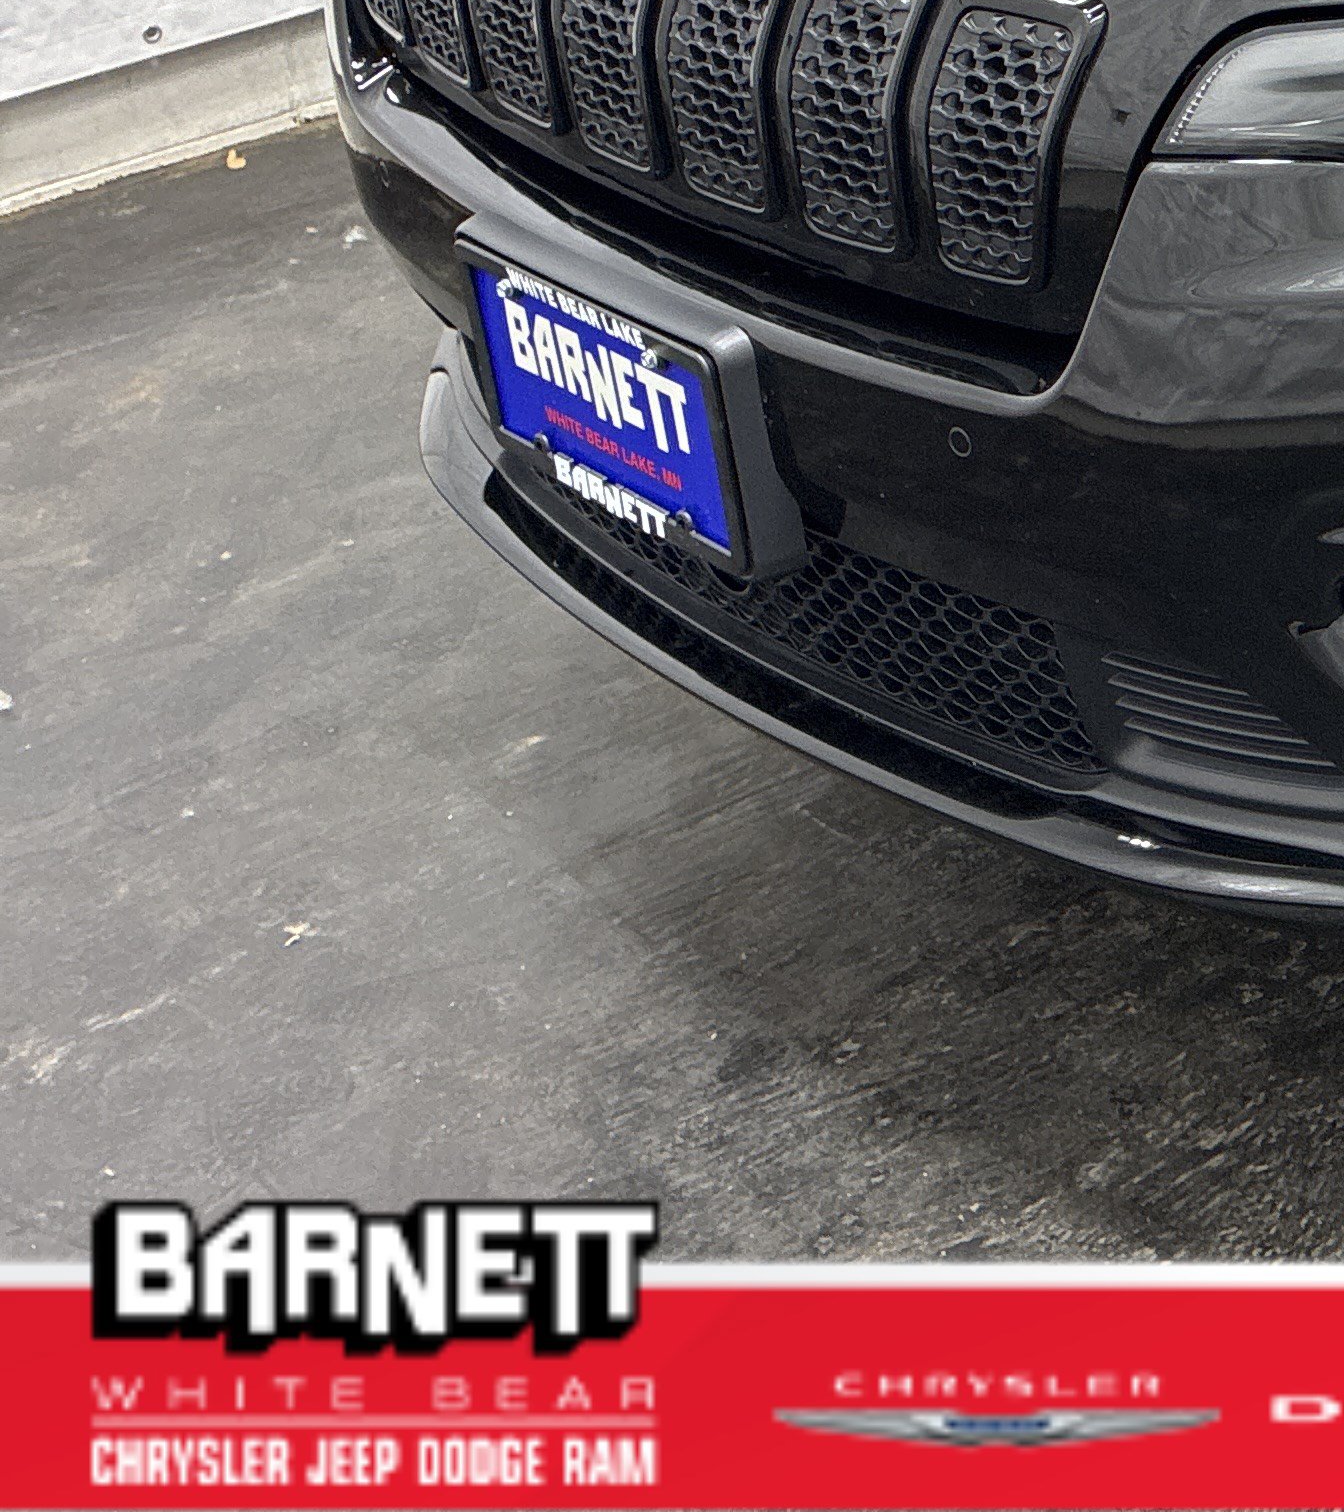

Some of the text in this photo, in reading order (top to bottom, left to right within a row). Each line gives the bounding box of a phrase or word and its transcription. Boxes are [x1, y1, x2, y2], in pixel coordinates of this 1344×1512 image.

[505, 266, 646, 351] WHITE BEAR LAKE
[503, 296, 692, 455] BARNETT
[544, 405, 584, 440] WHITE
[585, 426, 620, 459] BEAR
[553, 451, 670, 539] BARNETT
